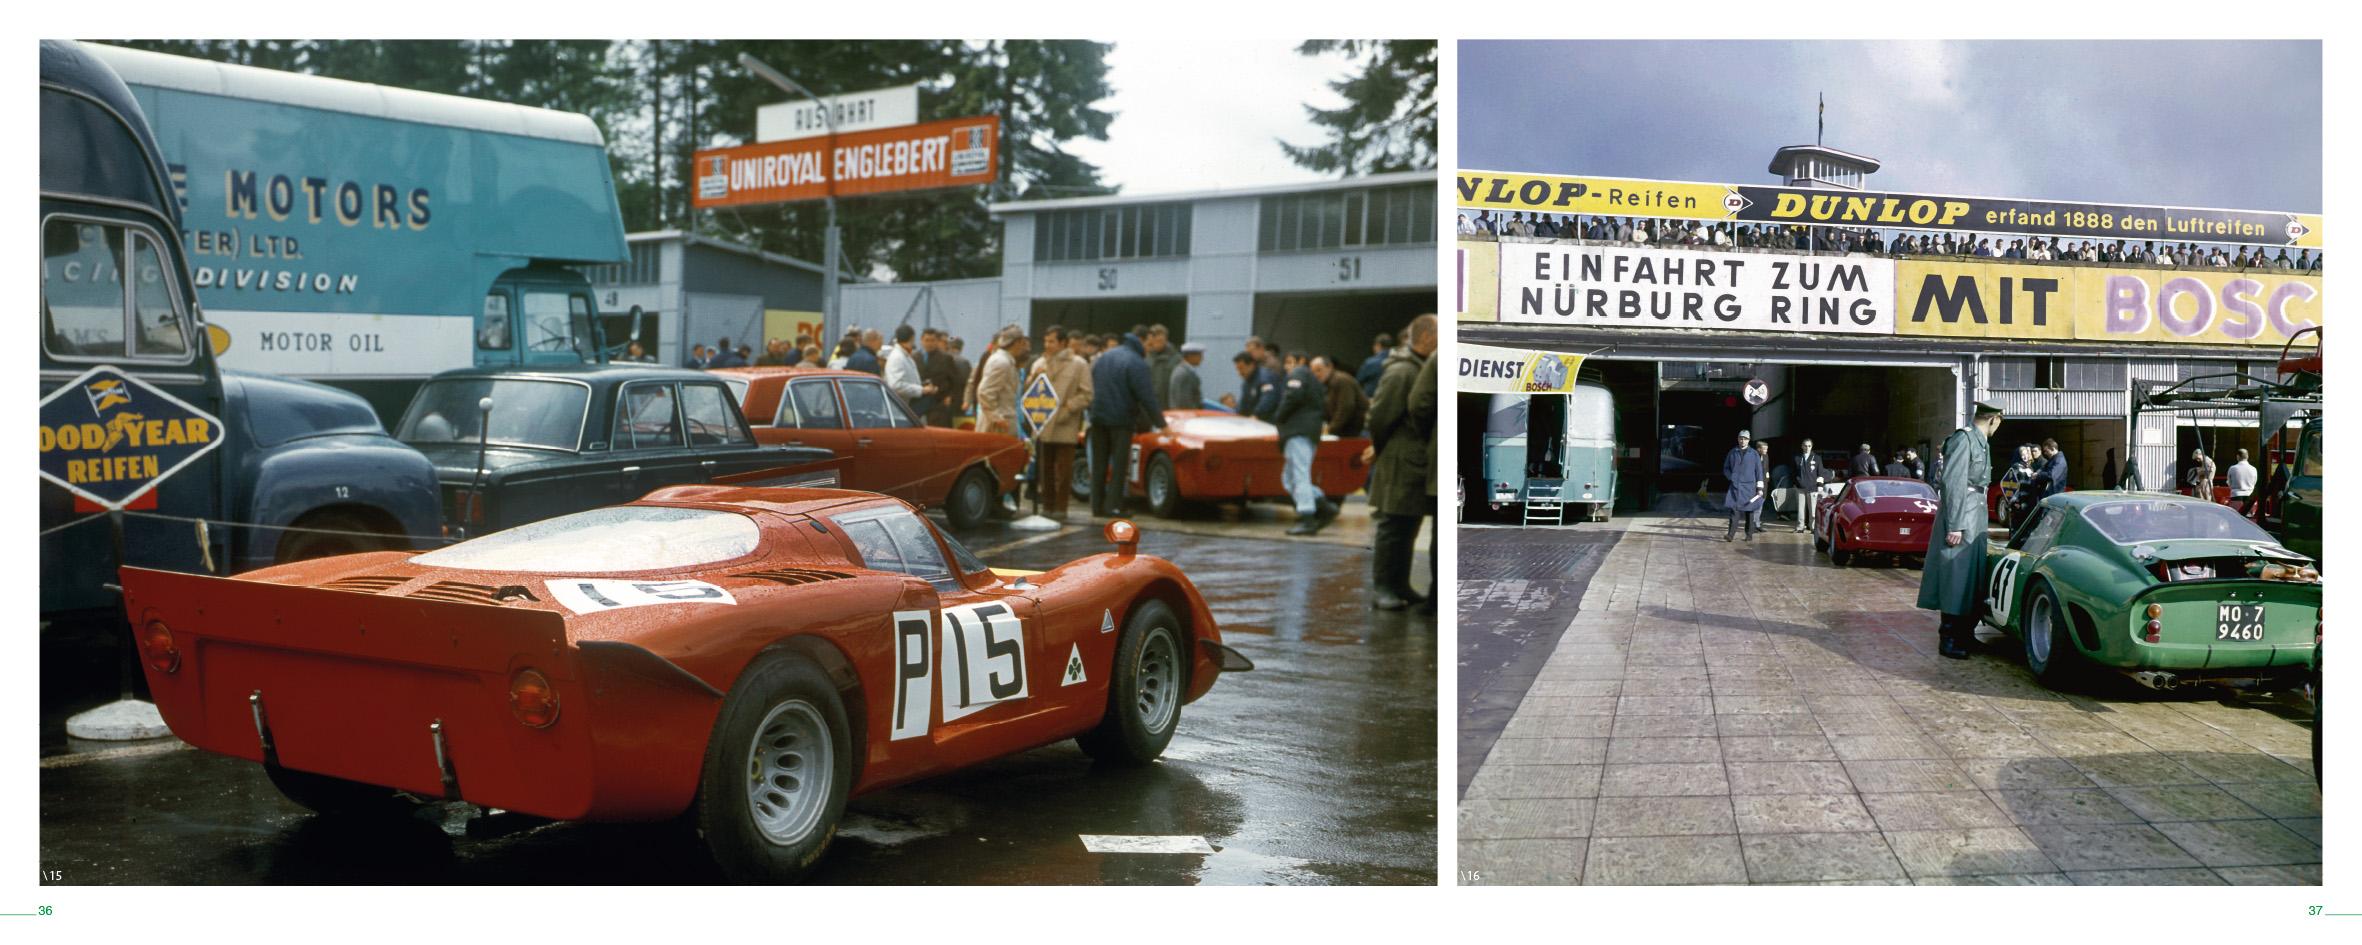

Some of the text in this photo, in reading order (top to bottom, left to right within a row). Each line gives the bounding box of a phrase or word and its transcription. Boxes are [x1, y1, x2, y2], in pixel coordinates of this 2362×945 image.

[731, 151, 826, 191] UNIROYAL
[833, 135, 949, 181] ENGLEBERT
[225, 170, 432, 232] MOTORS
[1771, 193, 2266, 237] DUNLOP erfand 1888 den Luftreifen
[250, 233, 304, 260] LTD.
[195, 267, 359, 294] DIVISION
[1098, 267, 1118, 291] 50
[1339, 256, 1361, 282] 51
[1535, 252, 1869, 293] EINFAHRT ZUM
[1521, 283, 1877, 326] NÜRBURG RING
[1911, 273, 2319, 339] MIT BOSC
[260, 332, 333, 352] MOTOR
[349, 333, 385, 353] OIL
[1459, 358, 1525, 379] DIENST
[1525, 382, 1552, 392] BOSCH
[67, 455, 158, 483] REIFEN
[335, 485, 350, 499] 12
[577, 581, 724, 607] 15
[1992, 558, 2016, 612] 47
[2218, 624, 2263, 640] 9460
